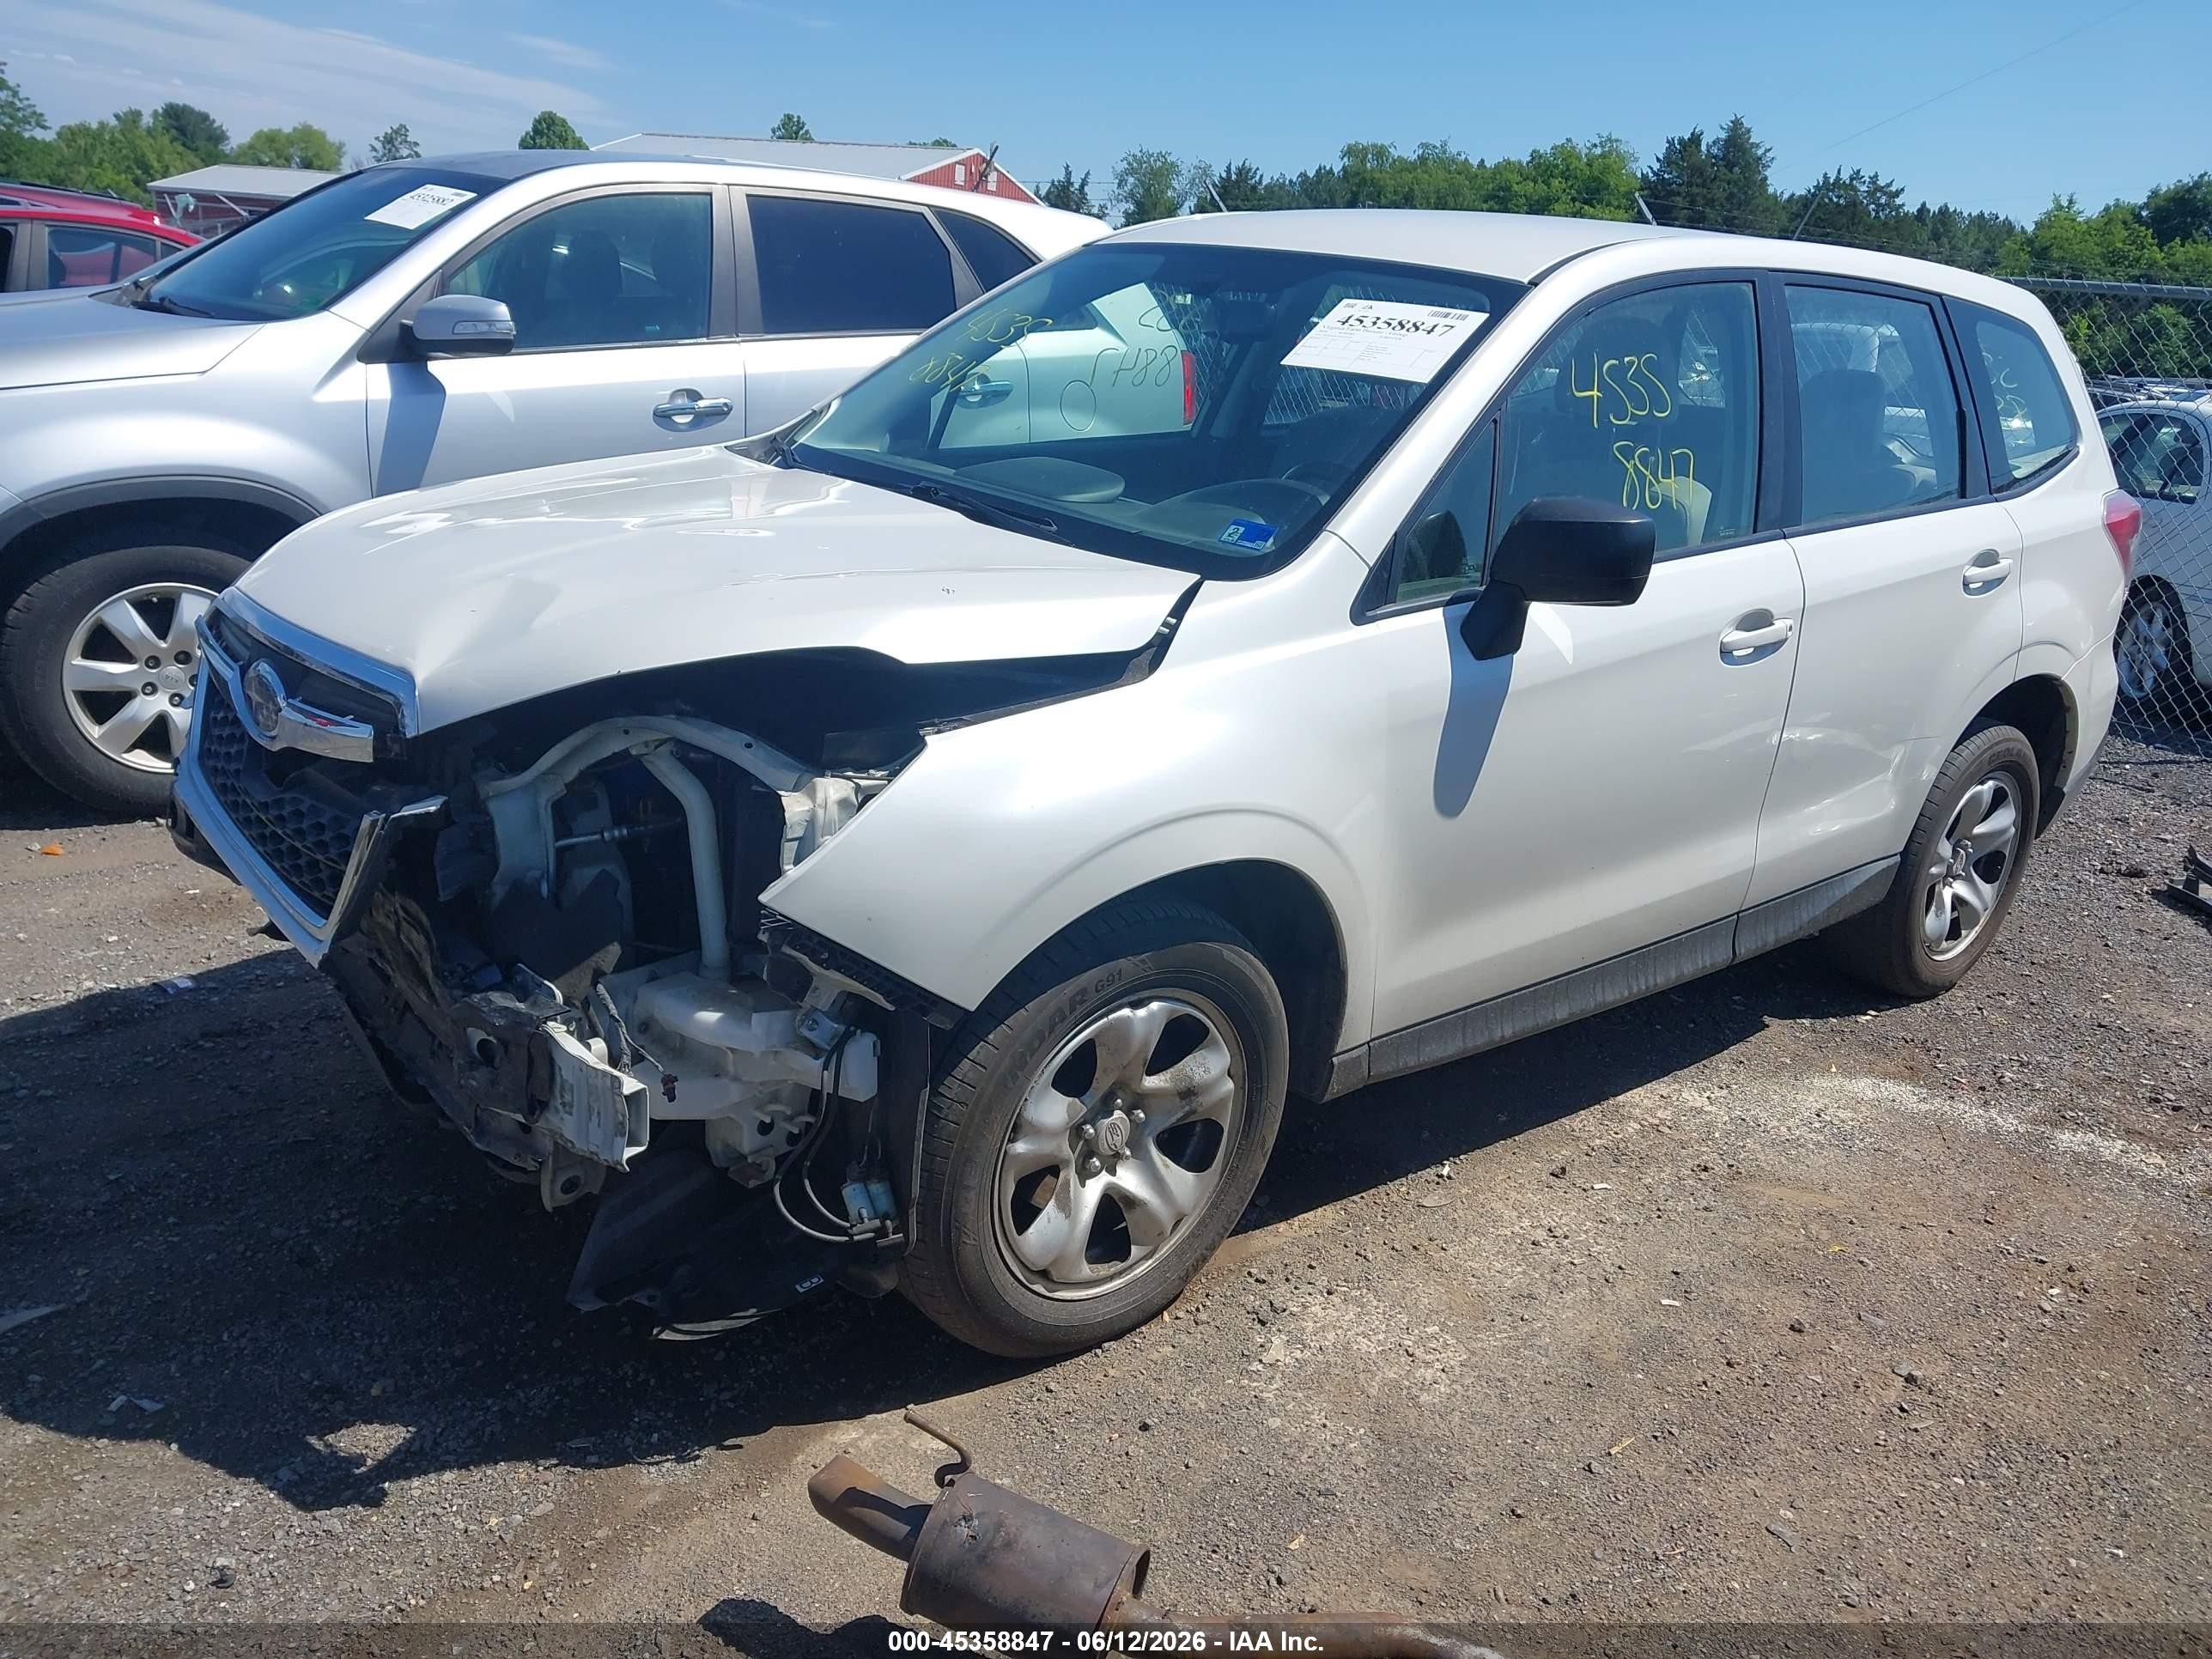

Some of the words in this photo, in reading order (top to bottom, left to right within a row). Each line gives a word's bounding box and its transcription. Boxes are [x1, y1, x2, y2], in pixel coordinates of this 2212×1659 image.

[1336, 313, 1457, 337] 45358847
[1612, 440, 1695, 511] 8847
[1094, 968, 1123, 994] G91
